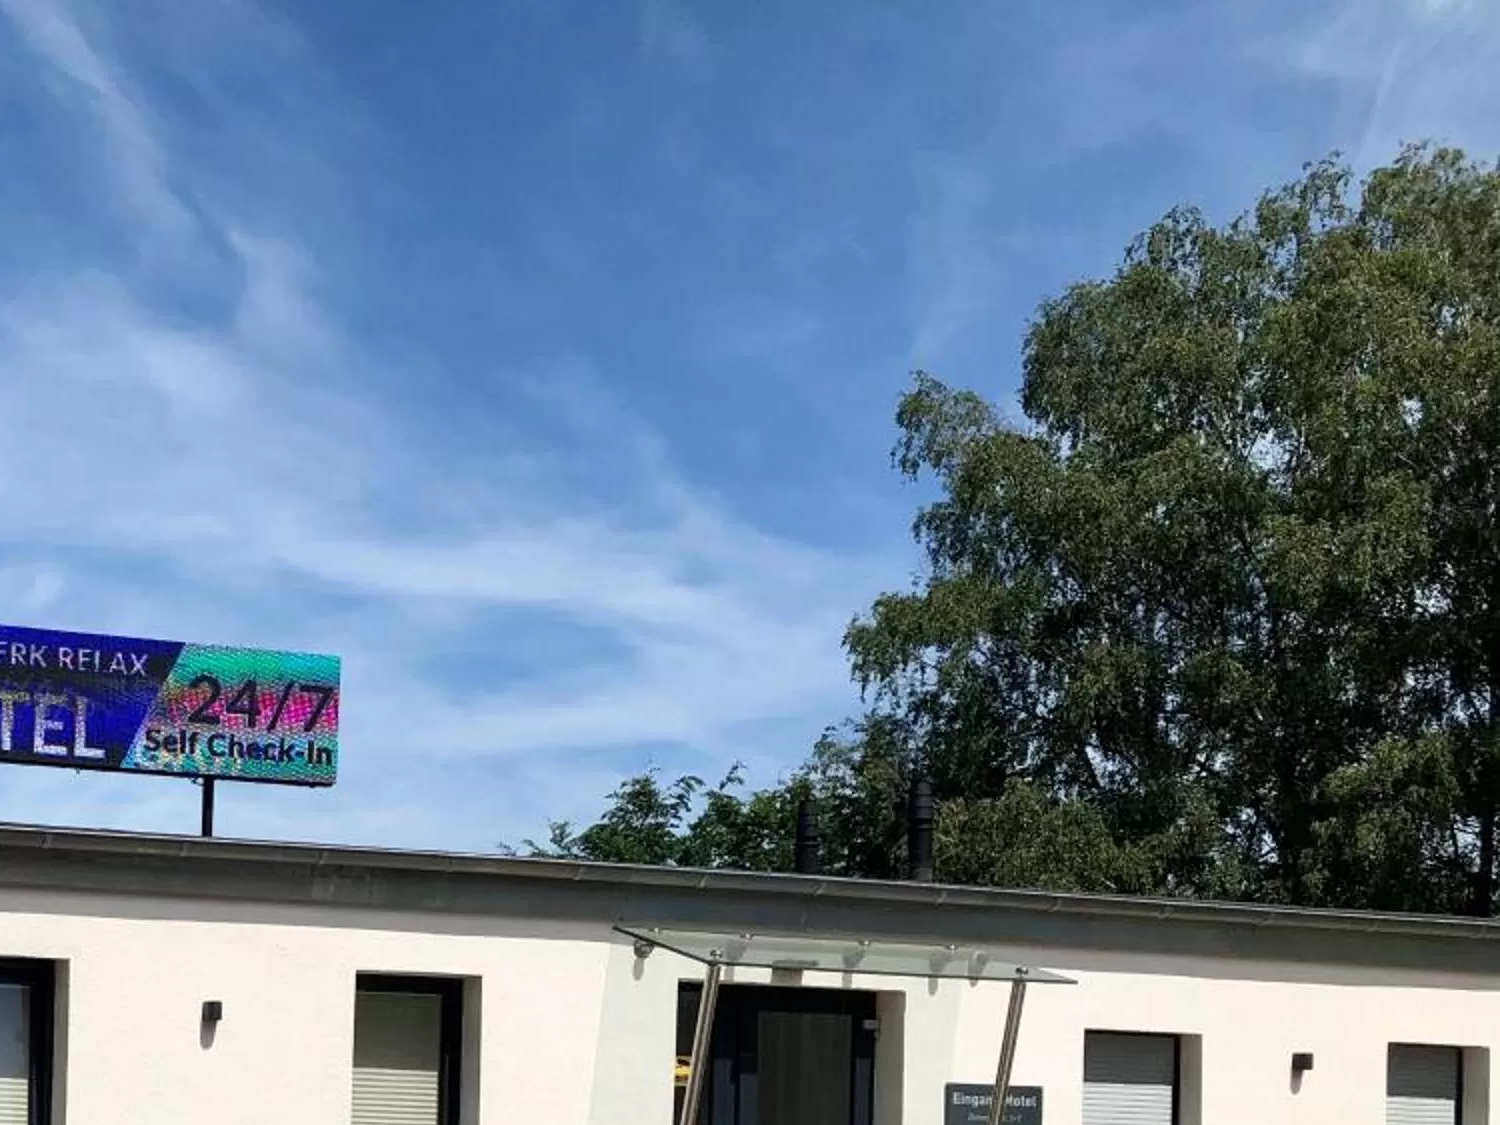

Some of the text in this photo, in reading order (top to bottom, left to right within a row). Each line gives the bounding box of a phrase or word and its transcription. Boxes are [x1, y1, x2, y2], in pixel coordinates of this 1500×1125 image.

[58, 646, 149, 677] RELAX
[187, 673, 334, 733] 24/7
[144, 727, 333, 766] Self Check-In
[953, 1092, 995, 1107] Eingan
